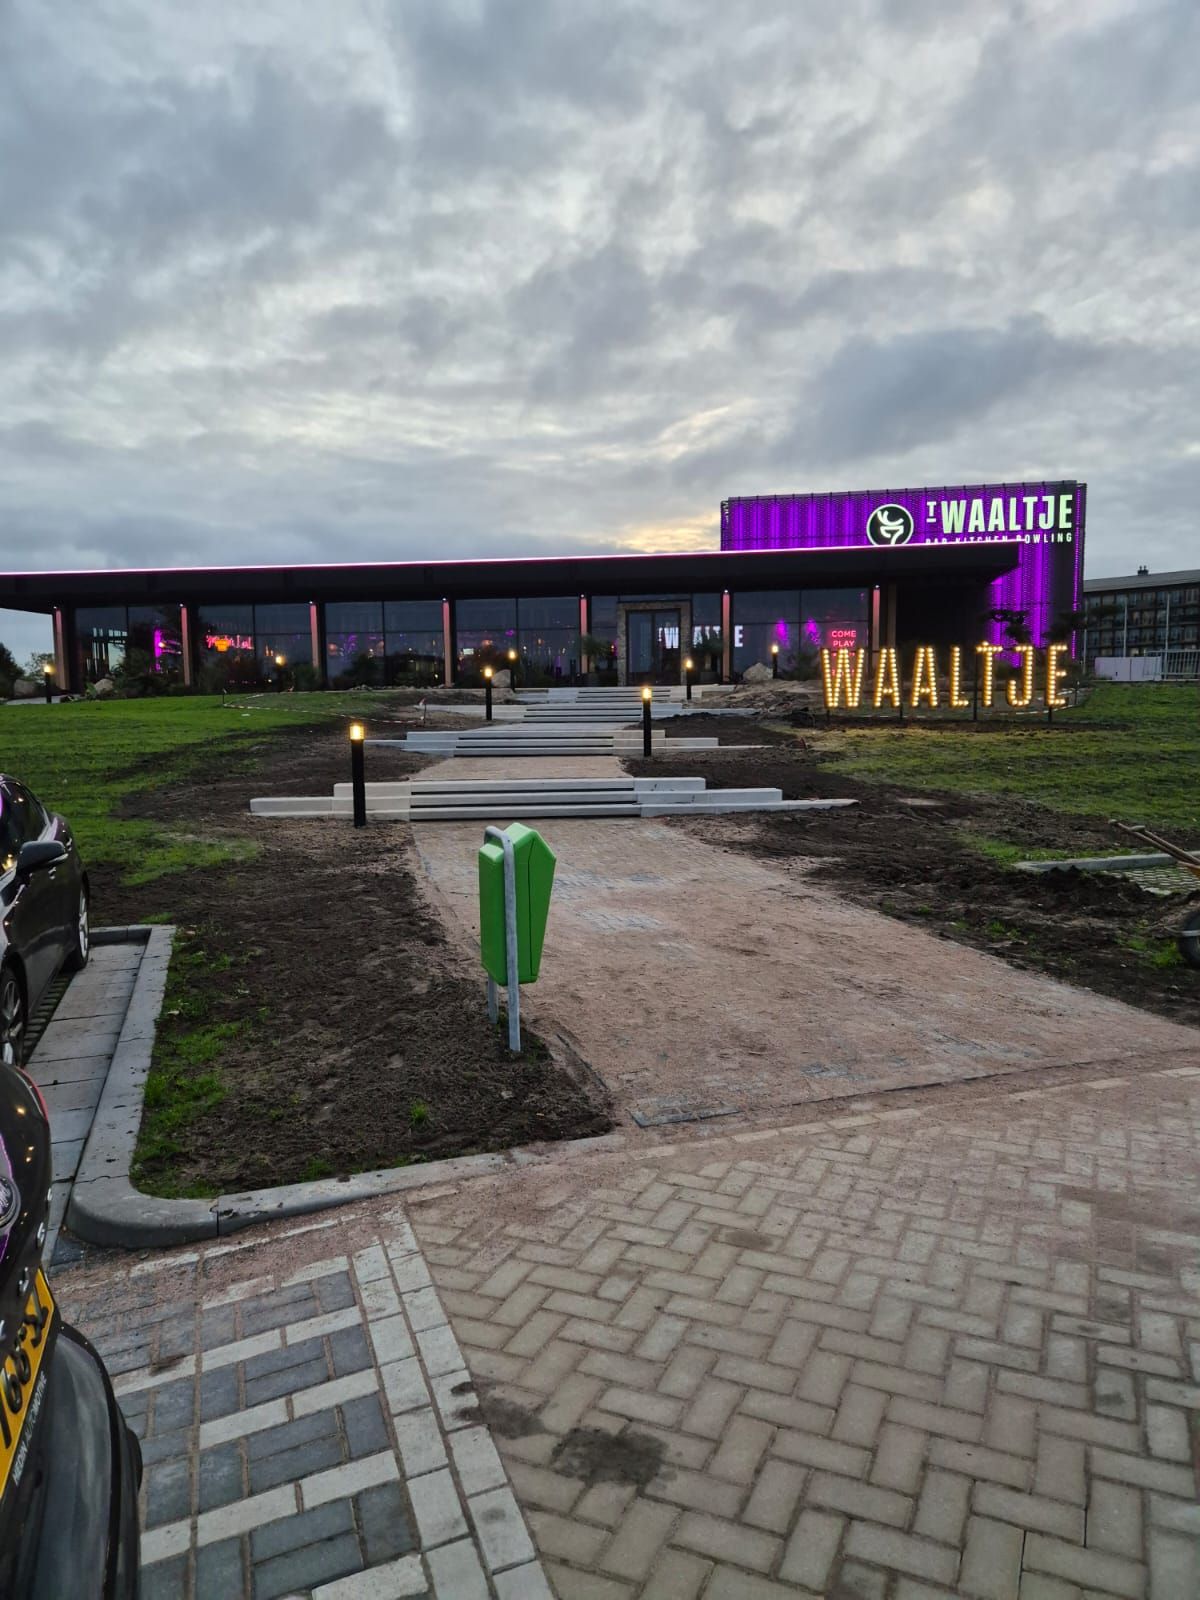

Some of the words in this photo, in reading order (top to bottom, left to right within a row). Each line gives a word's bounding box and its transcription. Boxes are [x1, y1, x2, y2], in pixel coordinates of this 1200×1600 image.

[941, 494, 1073, 534] WAALTJE
[1015, 532, 1073, 544] BOWLING
[831, 630, 857, 638] COME
[821, 643, 1068, 708] WAALTJE
